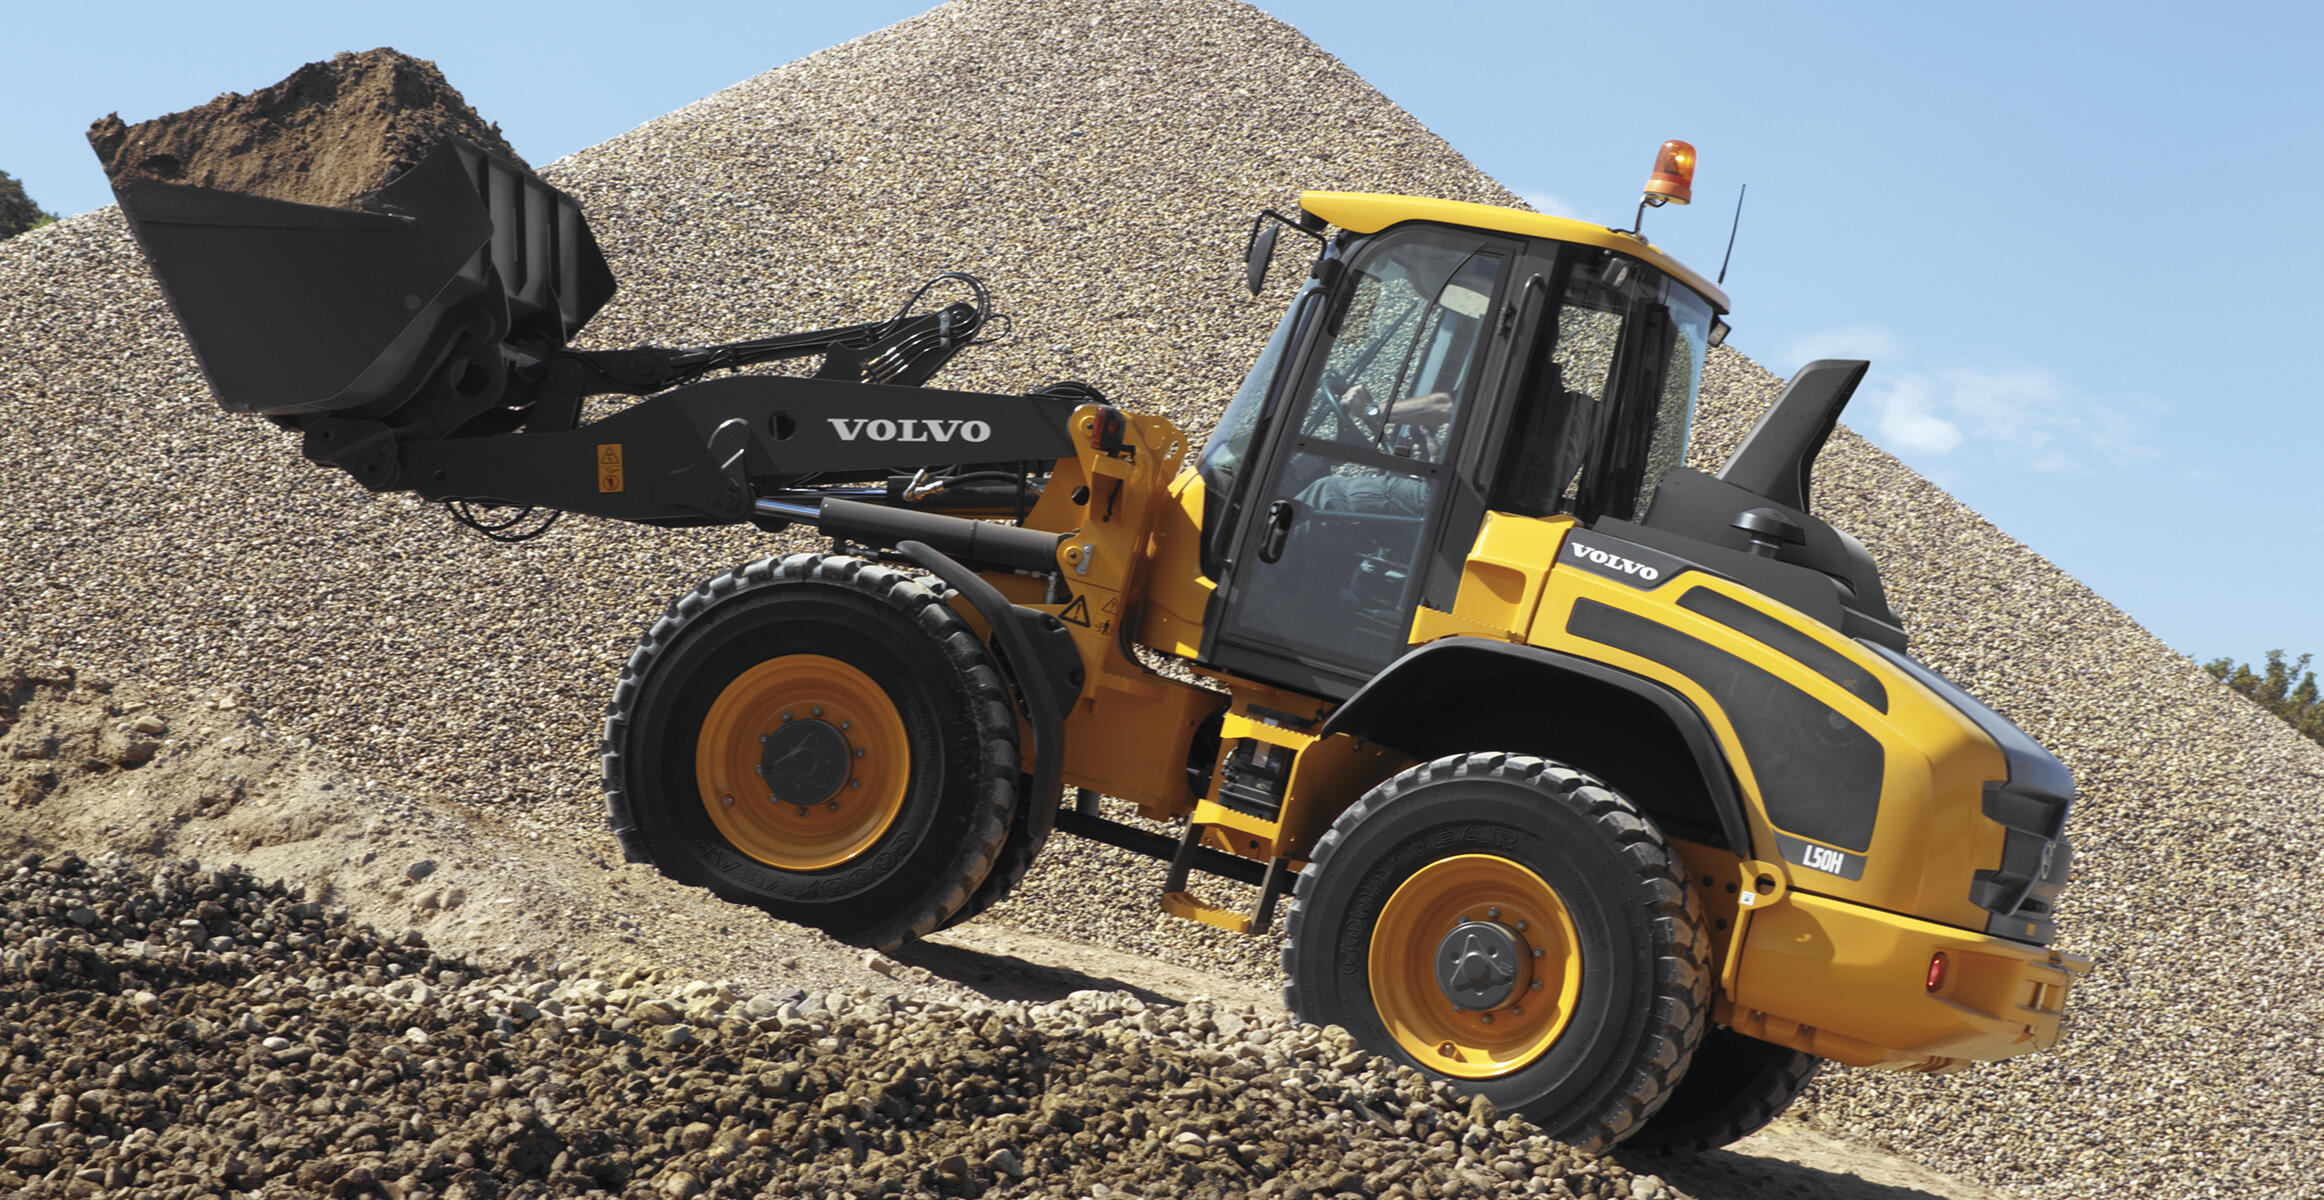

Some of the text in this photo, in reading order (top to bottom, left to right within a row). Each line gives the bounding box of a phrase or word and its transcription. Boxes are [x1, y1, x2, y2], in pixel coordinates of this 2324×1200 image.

[827, 418, 991, 442] VOLVO
[1571, 542, 1659, 581] VOLVO
[1802, 844, 1845, 875] L50H
[1343, 825, 1517, 977] GOODYEAR
